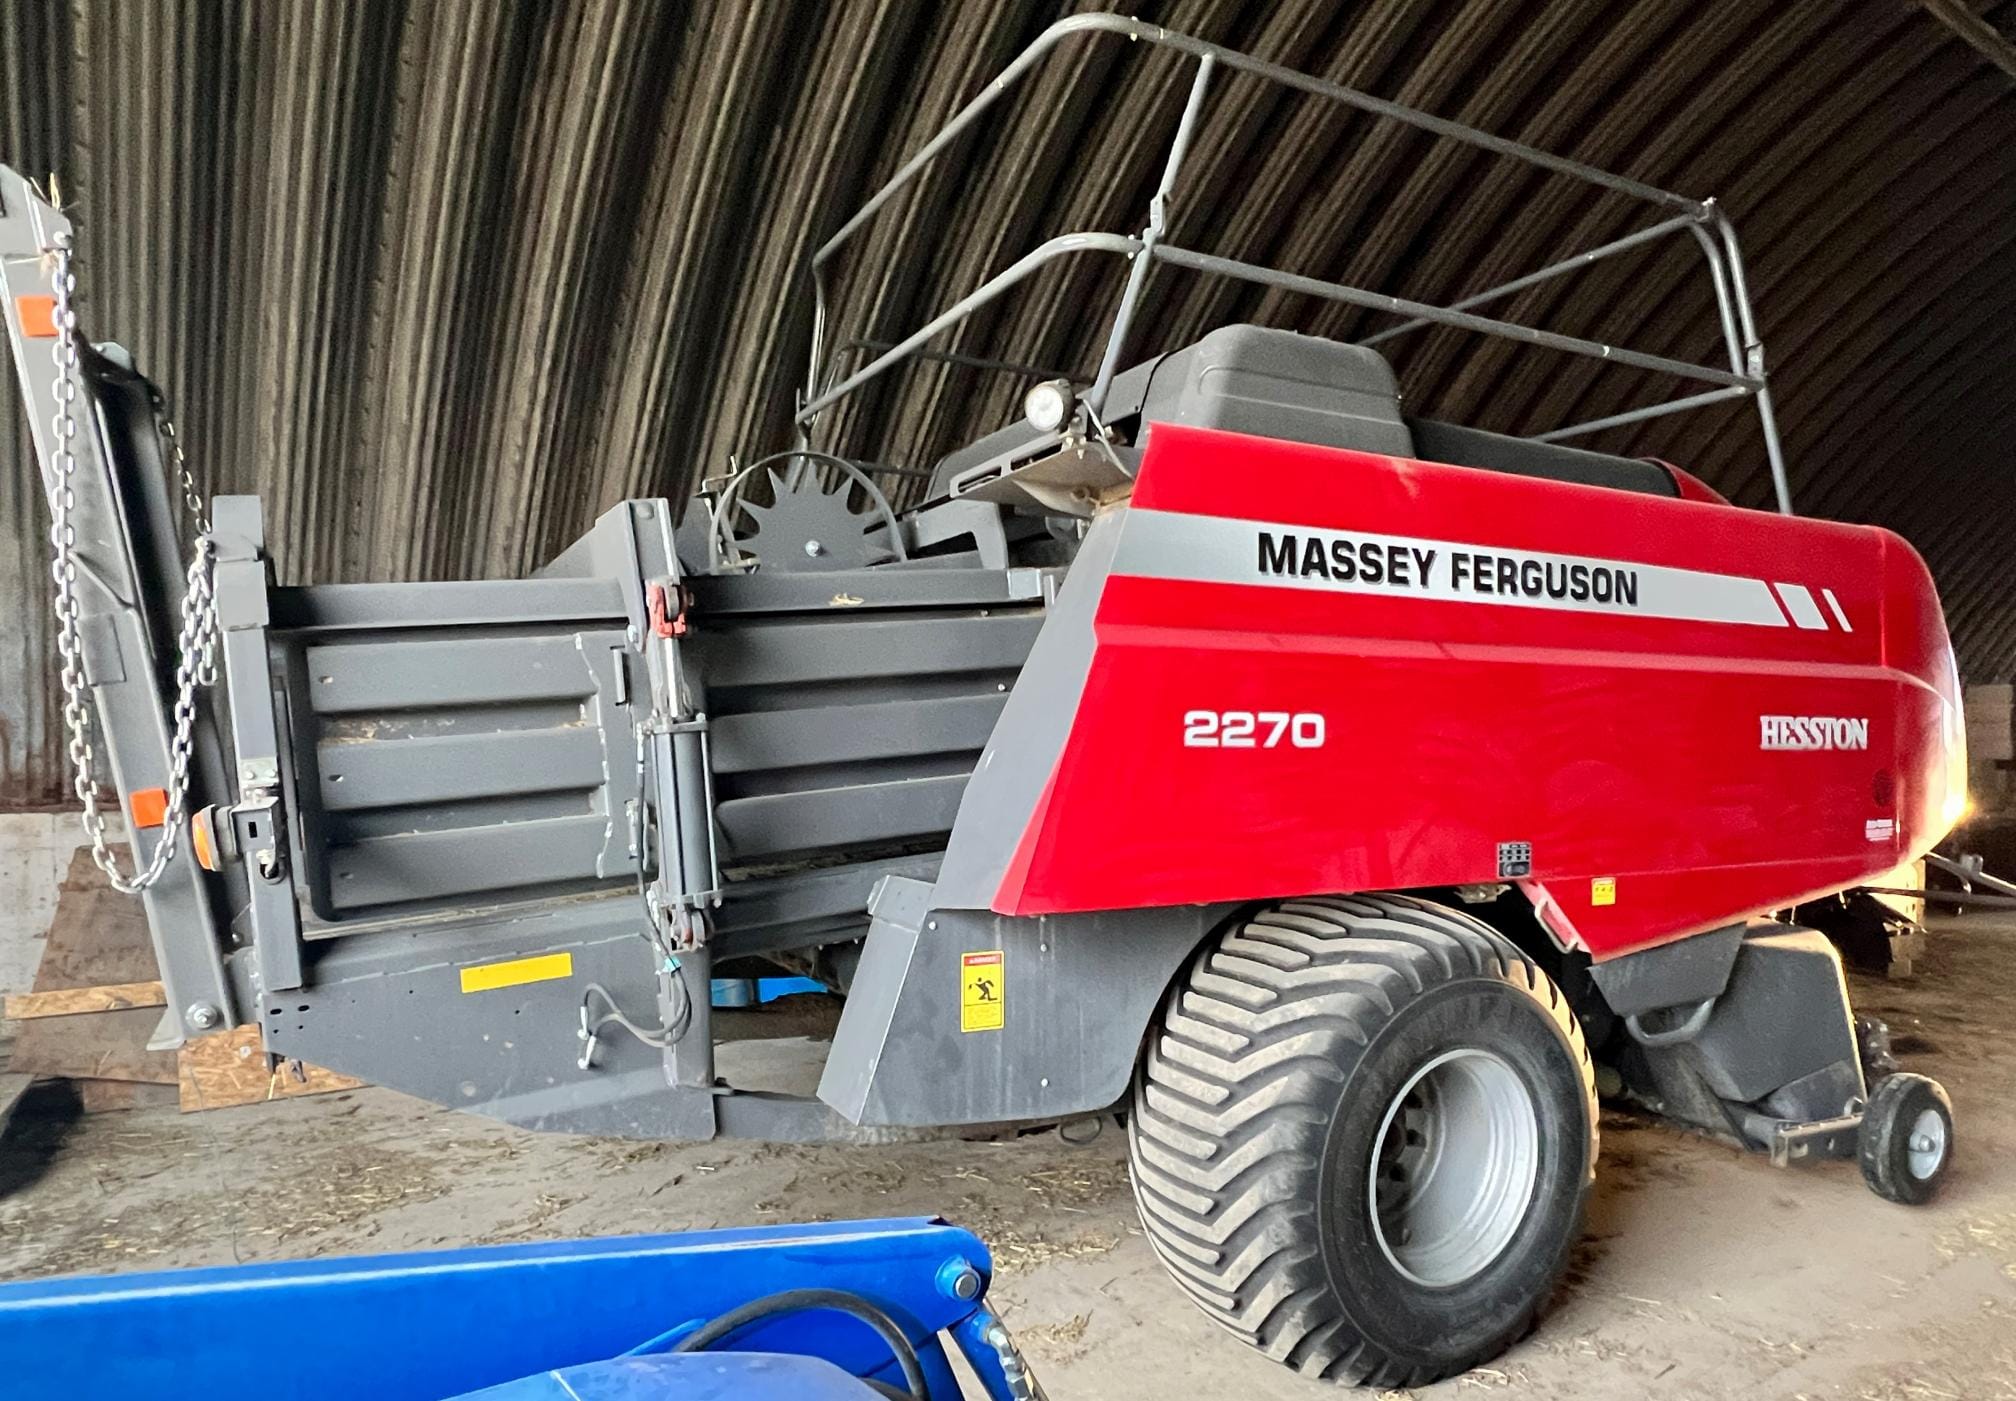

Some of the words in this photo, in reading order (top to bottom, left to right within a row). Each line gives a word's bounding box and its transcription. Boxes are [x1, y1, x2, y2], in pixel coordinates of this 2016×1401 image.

[1258, 532, 1436, 589] MASSEY
[1451, 552, 1638, 606] FERGUSON
[1183, 710, 1326, 748] 2270
[1759, 715, 1869, 751] HESSTON
